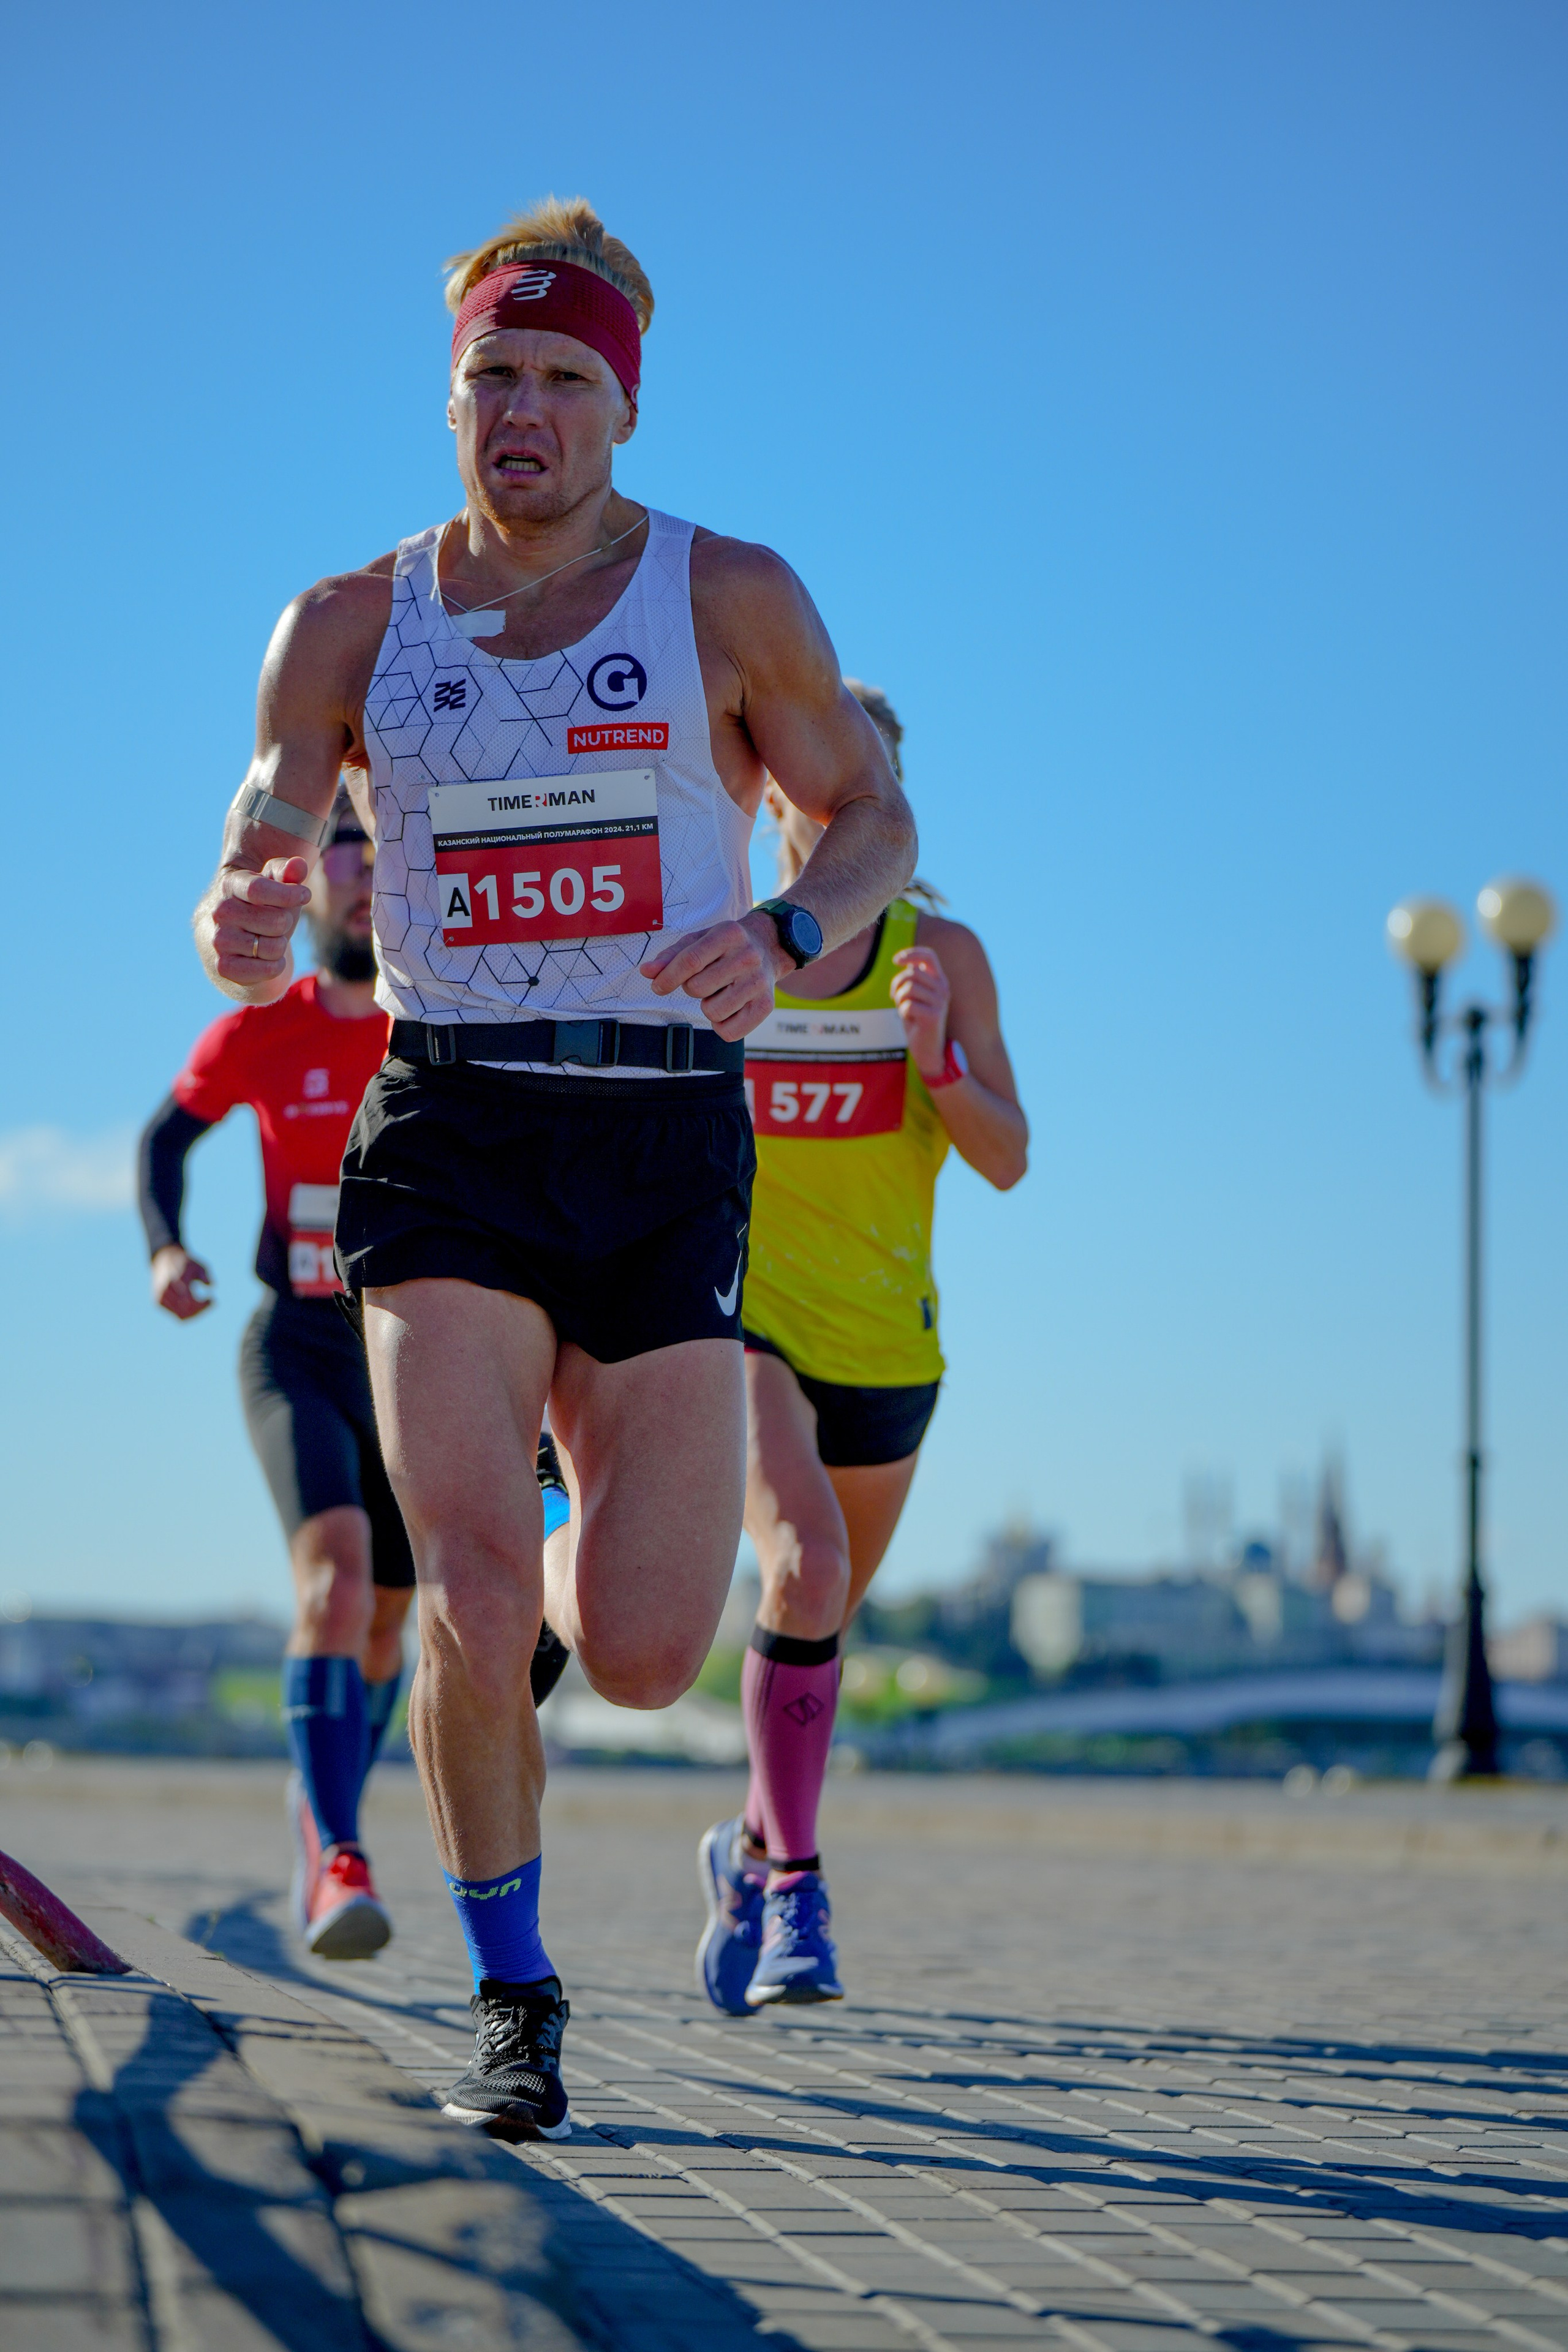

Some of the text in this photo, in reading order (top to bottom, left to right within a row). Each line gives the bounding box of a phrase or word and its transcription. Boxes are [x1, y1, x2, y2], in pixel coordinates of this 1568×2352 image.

[574, 729, 665, 747] NUTREND
[438, 837, 480, 847] КАЗАНСКИЙ
[481, 831, 543, 843] НАЦИОНАЛЬНЫЙ
[544, 827, 603, 839] ПОЛУМАРАФОН
[605, 826, 625, 834] 2024.
[447, 864, 625, 920] A 1505
[769, 1082, 864, 1123] 577
